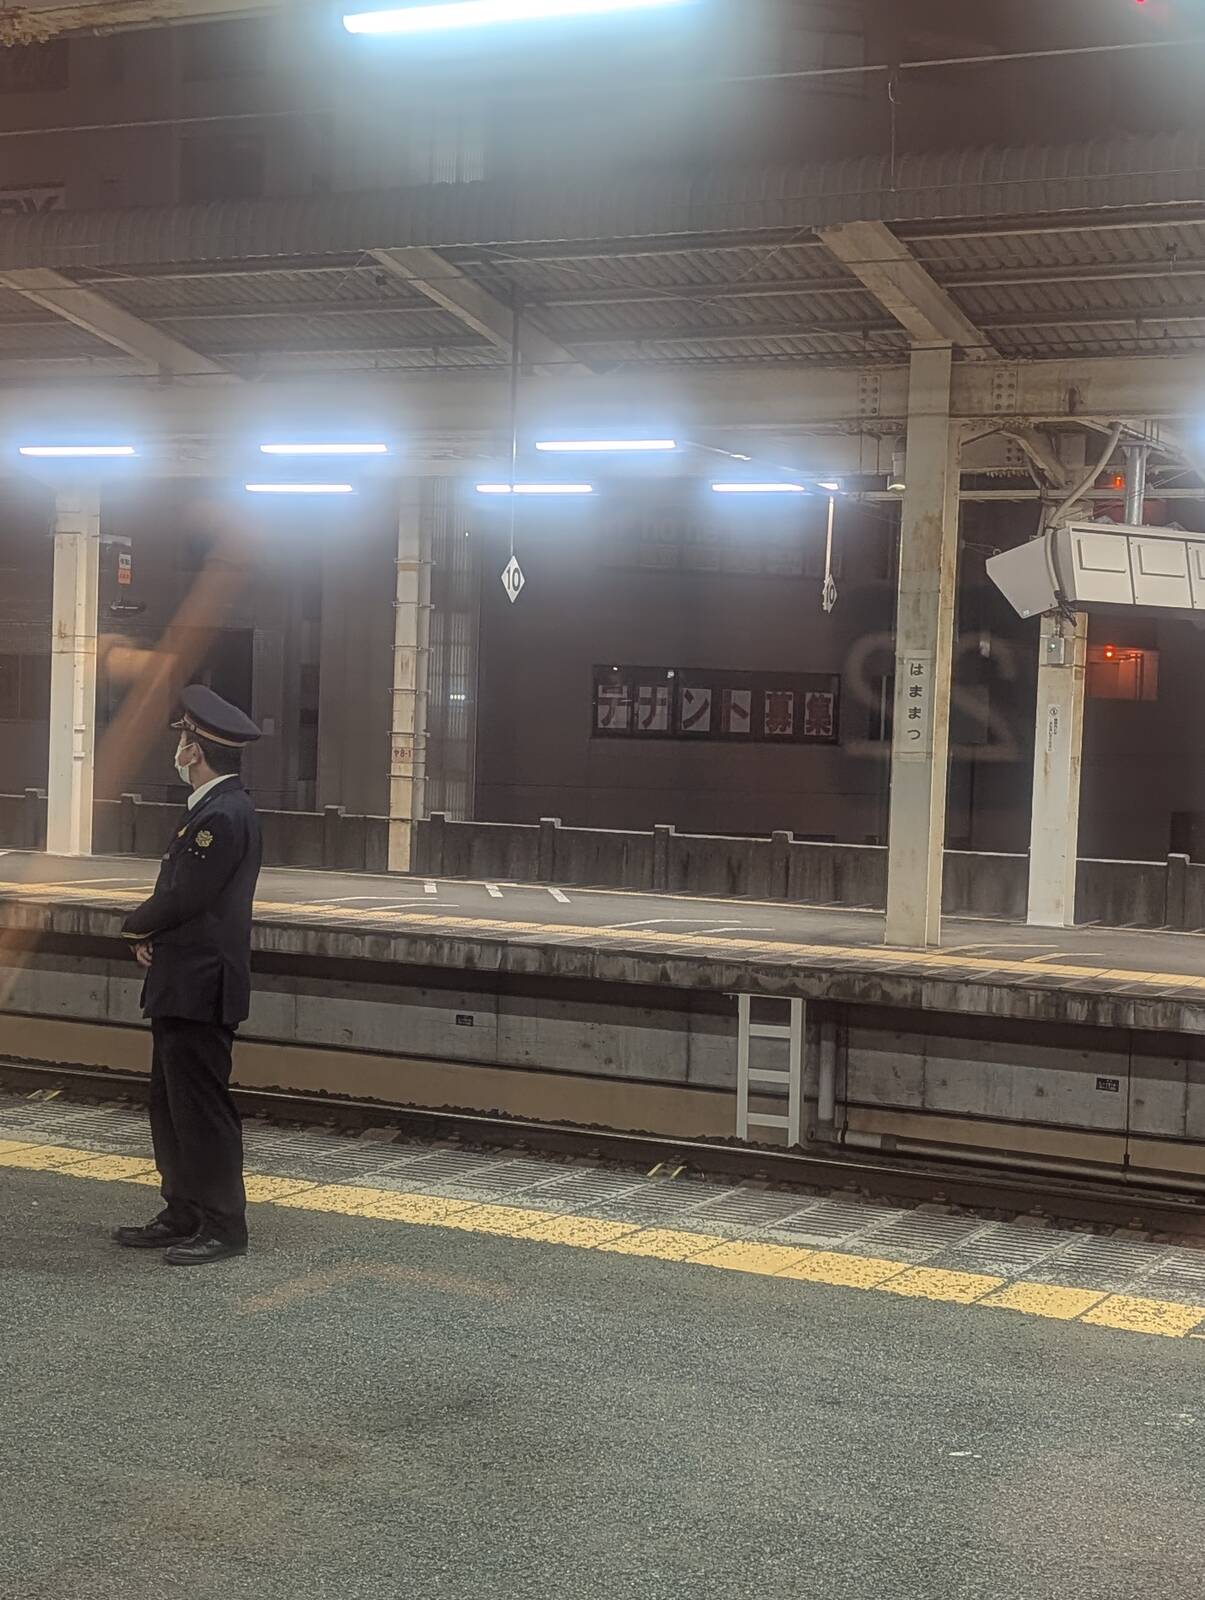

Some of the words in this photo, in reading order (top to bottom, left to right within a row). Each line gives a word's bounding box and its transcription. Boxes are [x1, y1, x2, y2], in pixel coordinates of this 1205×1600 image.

[506, 566, 521, 591] 10
[597, 684, 833, 736] テナント募集
[907, 662, 924, 740] はままつ
